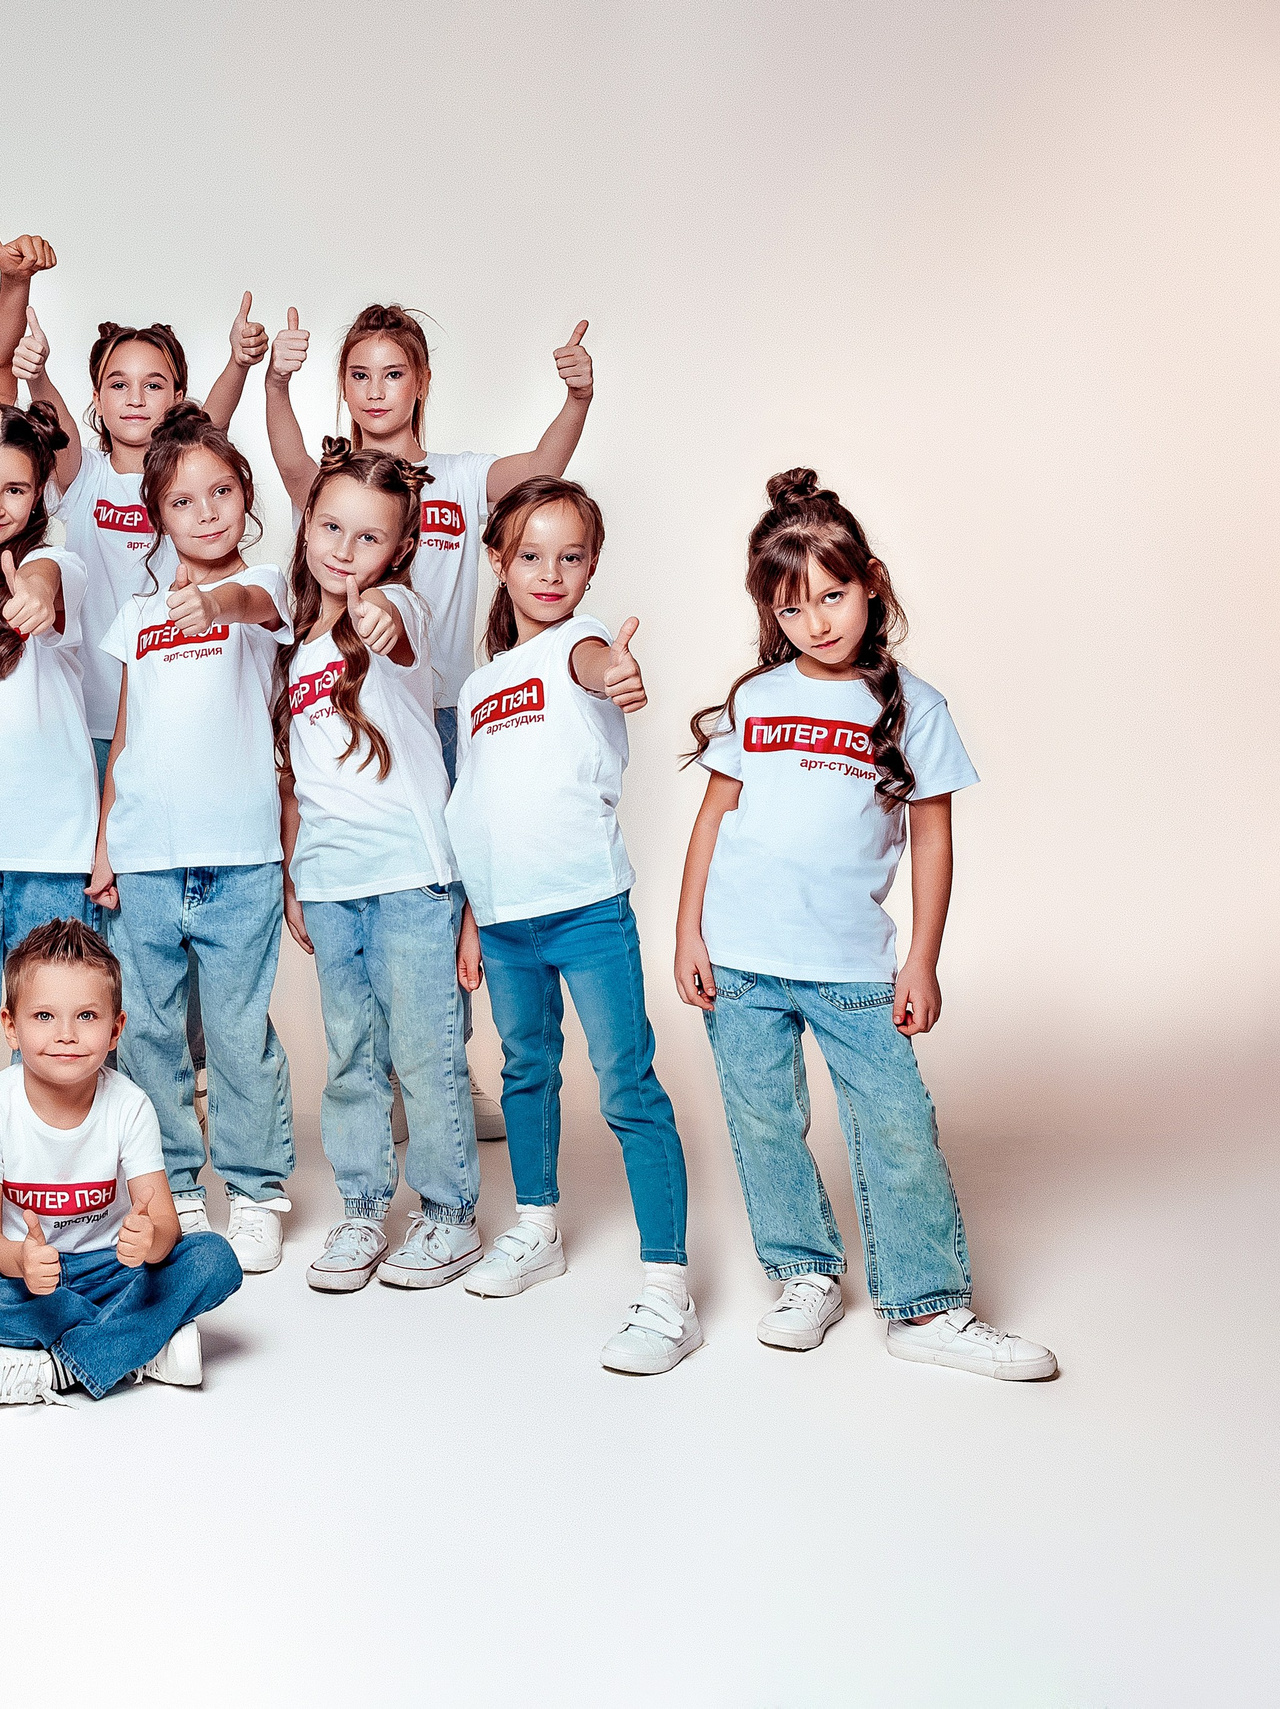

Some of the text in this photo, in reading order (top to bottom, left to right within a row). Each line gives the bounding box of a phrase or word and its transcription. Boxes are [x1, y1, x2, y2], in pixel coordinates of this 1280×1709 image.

[426, 507, 460, 529] ПЭН
[140, 626, 180, 653] ПИТЕР
[163, 647, 223, 663] арт-студия
[501, 685, 538, 713] ПЭН
[486, 714, 545, 735] арт-студия
[751, 724, 828, 745] ПИТЕР
[800, 757, 877, 781] арт-студия
[7, 1186, 113, 1209] ПИТЕР ПЭН
[53, 1209, 109, 1229] арт-студия
